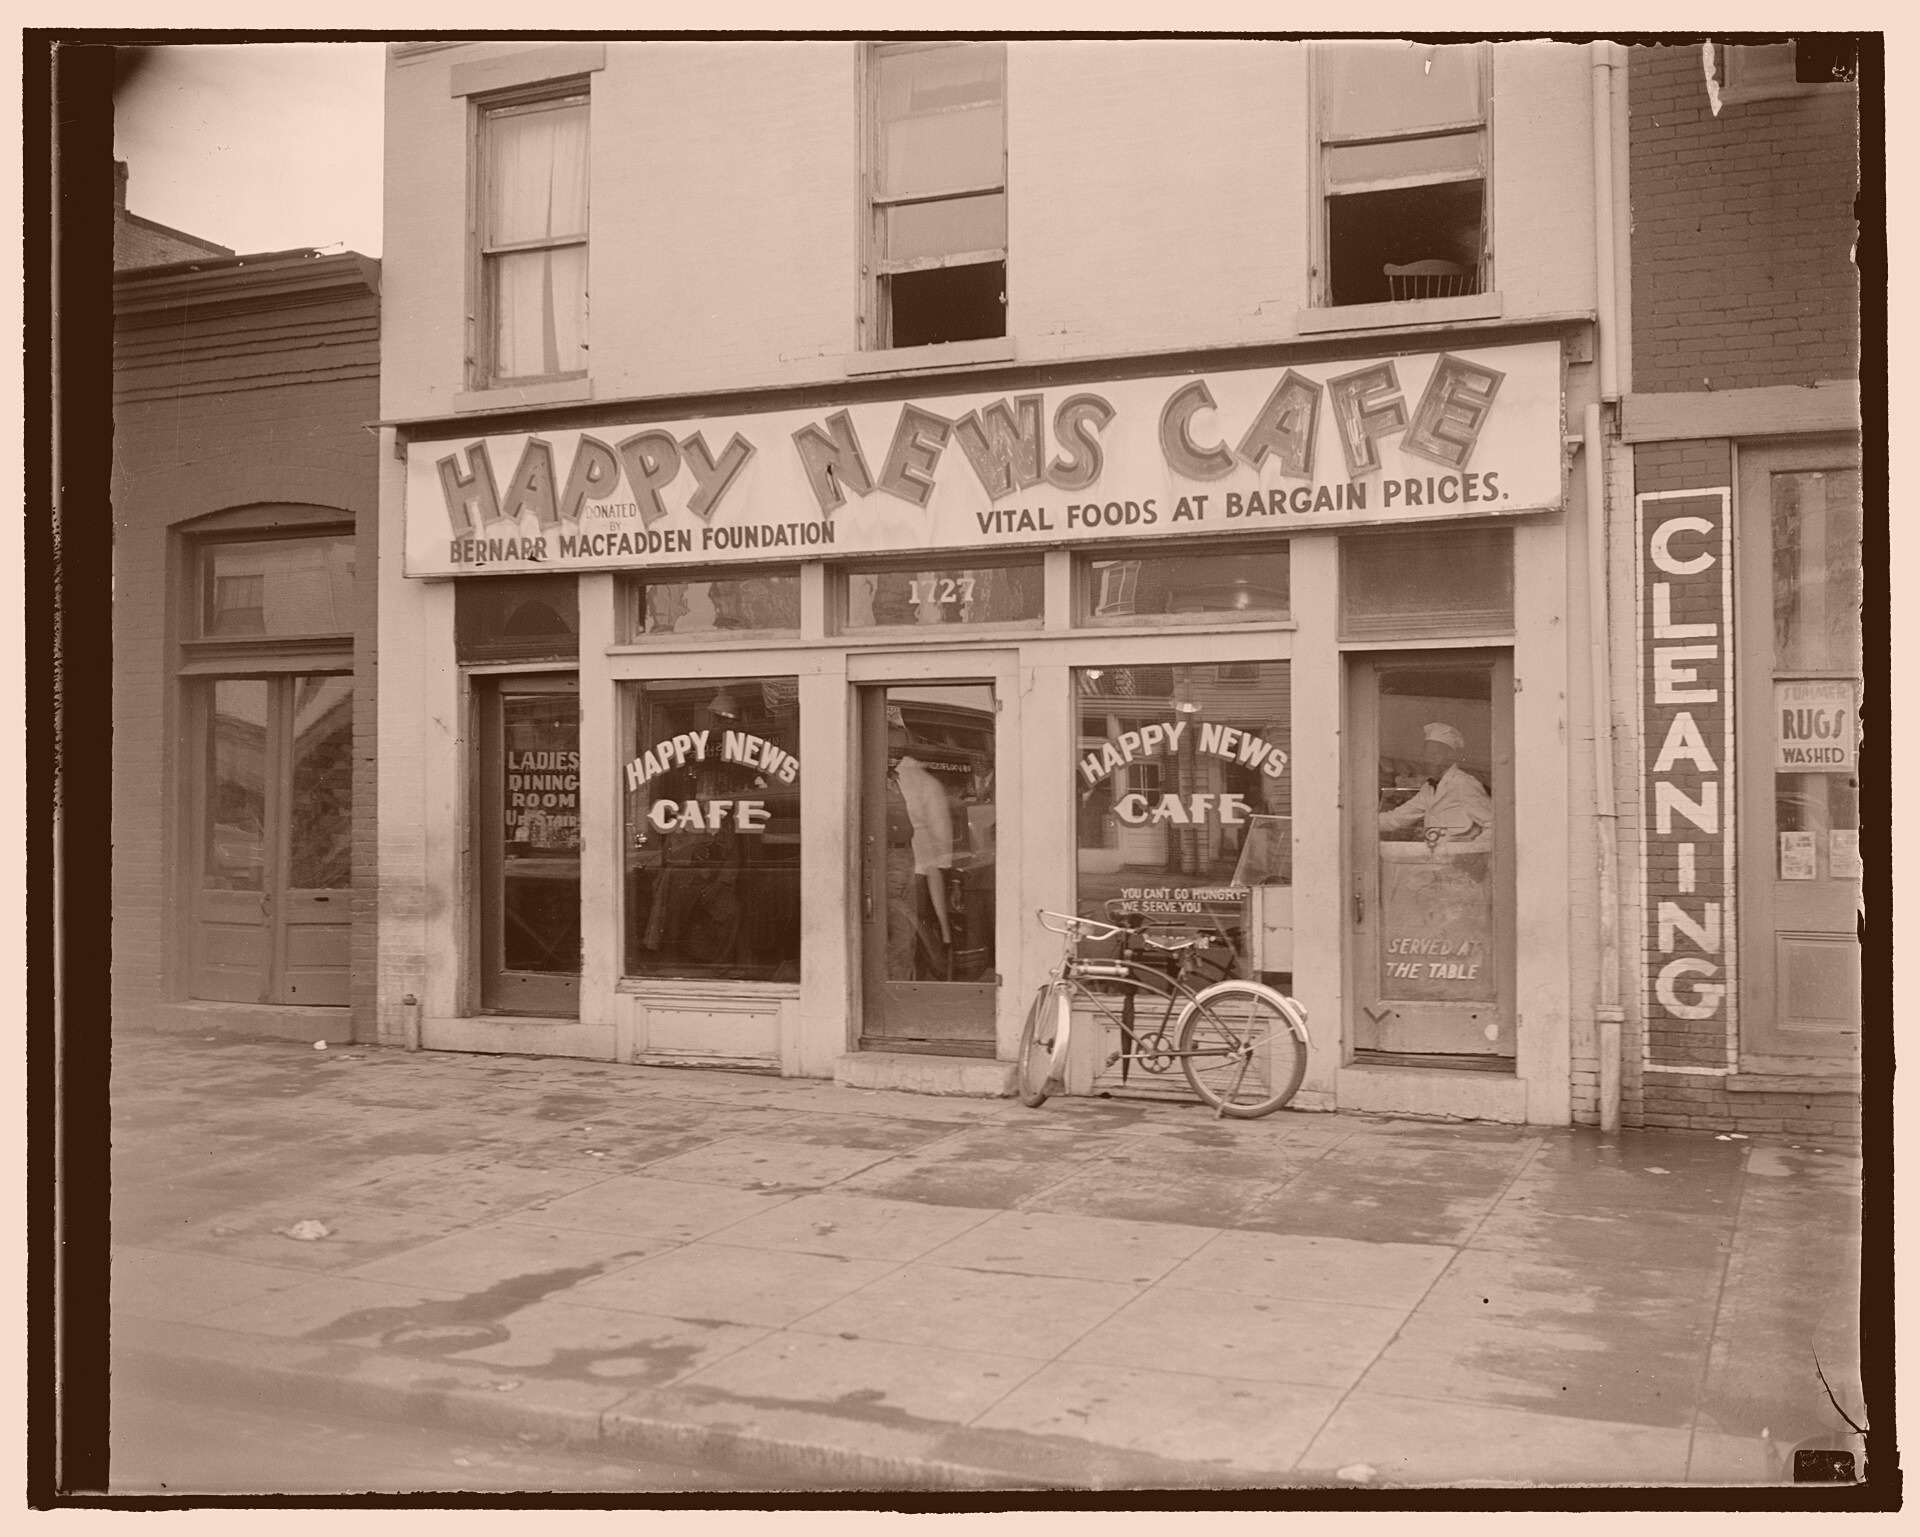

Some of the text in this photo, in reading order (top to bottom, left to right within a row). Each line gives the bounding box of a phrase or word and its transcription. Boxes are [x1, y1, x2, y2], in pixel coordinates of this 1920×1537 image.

[436, 351, 1506, 538] HAPPY NEWS CAFE
[585, 502, 637, 519] DONATED
[976, 471, 1509, 534] VITAL FOODS AT BARGAIN PRICES.
[450, 520, 835, 563] BERNARR MACFADDEN FOUNDATION
[908, 577, 976, 604] 1727
[1781, 709, 1847, 741] RUGS
[508, 751, 580, 770] LADIES
[625, 729, 800, 792] HAPPY NEWS
[1079, 721, 1288, 784] HAPPY NEWS
[1782, 747, 1845, 764] WASHED
[1650, 516, 1725, 1021] CLEANING
[508, 774, 580, 791] DINING
[511, 793, 576, 808] ROOM
[1113, 793, 1253, 825] CAFE
[647, 799, 772, 832] CAFE
[1121, 888, 1142, 900] YOU
[1174, 888, 1190, 900] GO
[1121, 901, 1202, 913] WE SERVE YOU
[1387, 938, 1483, 956] SERVED AT
[1386, 962, 1480, 980] THE TABLE
